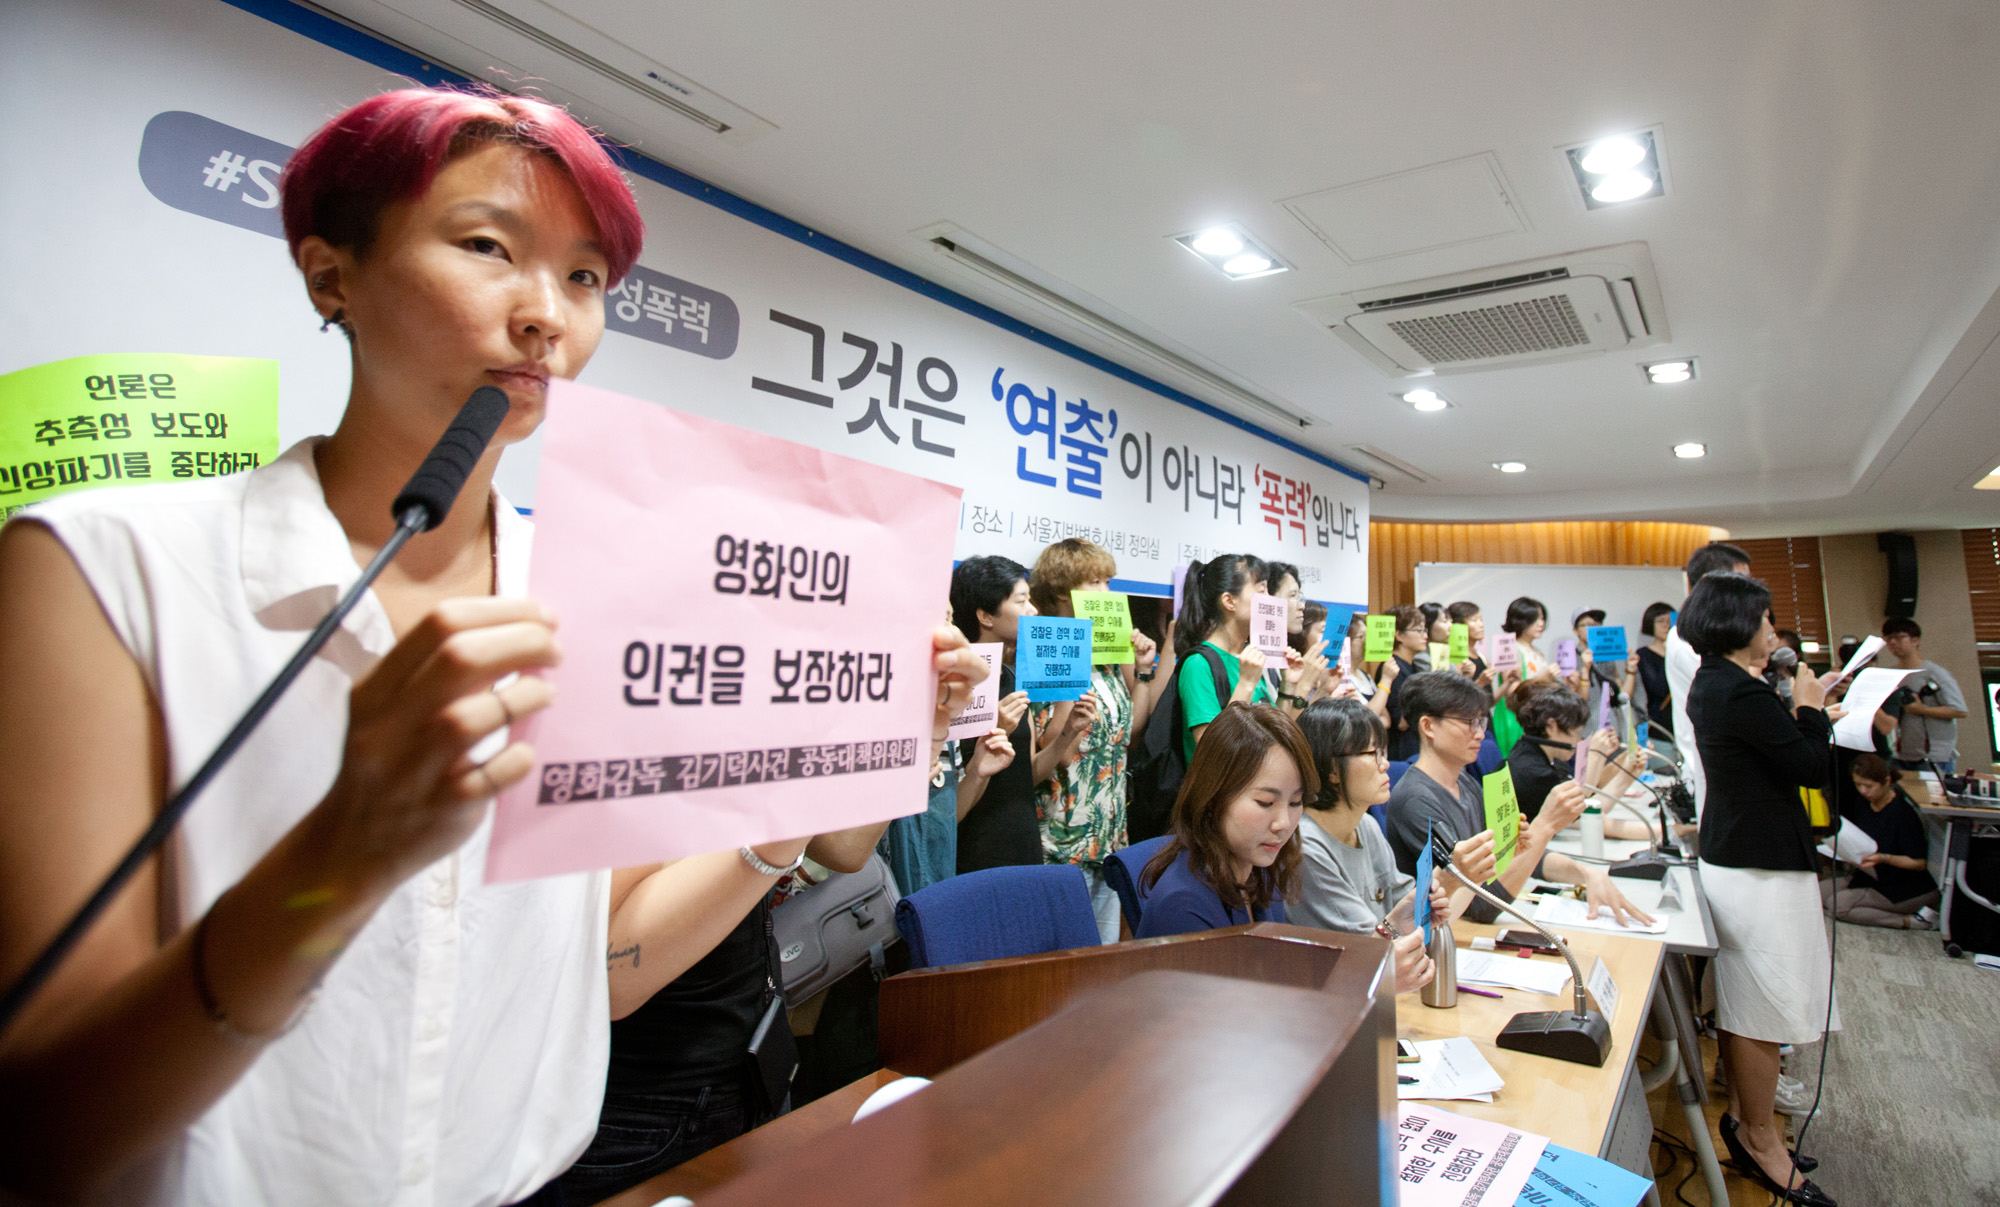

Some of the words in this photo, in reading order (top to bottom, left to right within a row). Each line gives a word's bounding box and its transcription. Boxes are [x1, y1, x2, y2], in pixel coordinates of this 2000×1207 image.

[608, 278, 711, 344] 성폭력
[85, 373, 177, 401] 언론은
[34, 412, 132, 447] 추측성
[151, 412, 228, 439] 보도와
[751, 308, 966, 458] 그것은
[1162, 445, 1245, 525] 아니라
[171, 451, 260, 478] 중단하라
[971, 505, 1003, 534] 장소
[1129, 534, 1160, 560] 정의실
[714, 533, 850, 606] 영화인의
[1030, 625, 1053, 640] 검찰은
[623, 640, 746, 706] 인권을
[770, 648, 893, 705] 보장하라
[544, 758, 667, 803] 영화감독
[676, 748, 791, 790] 김기덕사건
[798, 737, 917, 777] 공동대책위원회
[784, 944, 801, 959] JVC
[1420, 1129, 1458, 1155] 수사를
[1439, 1147, 1485, 1183] 진행하라
